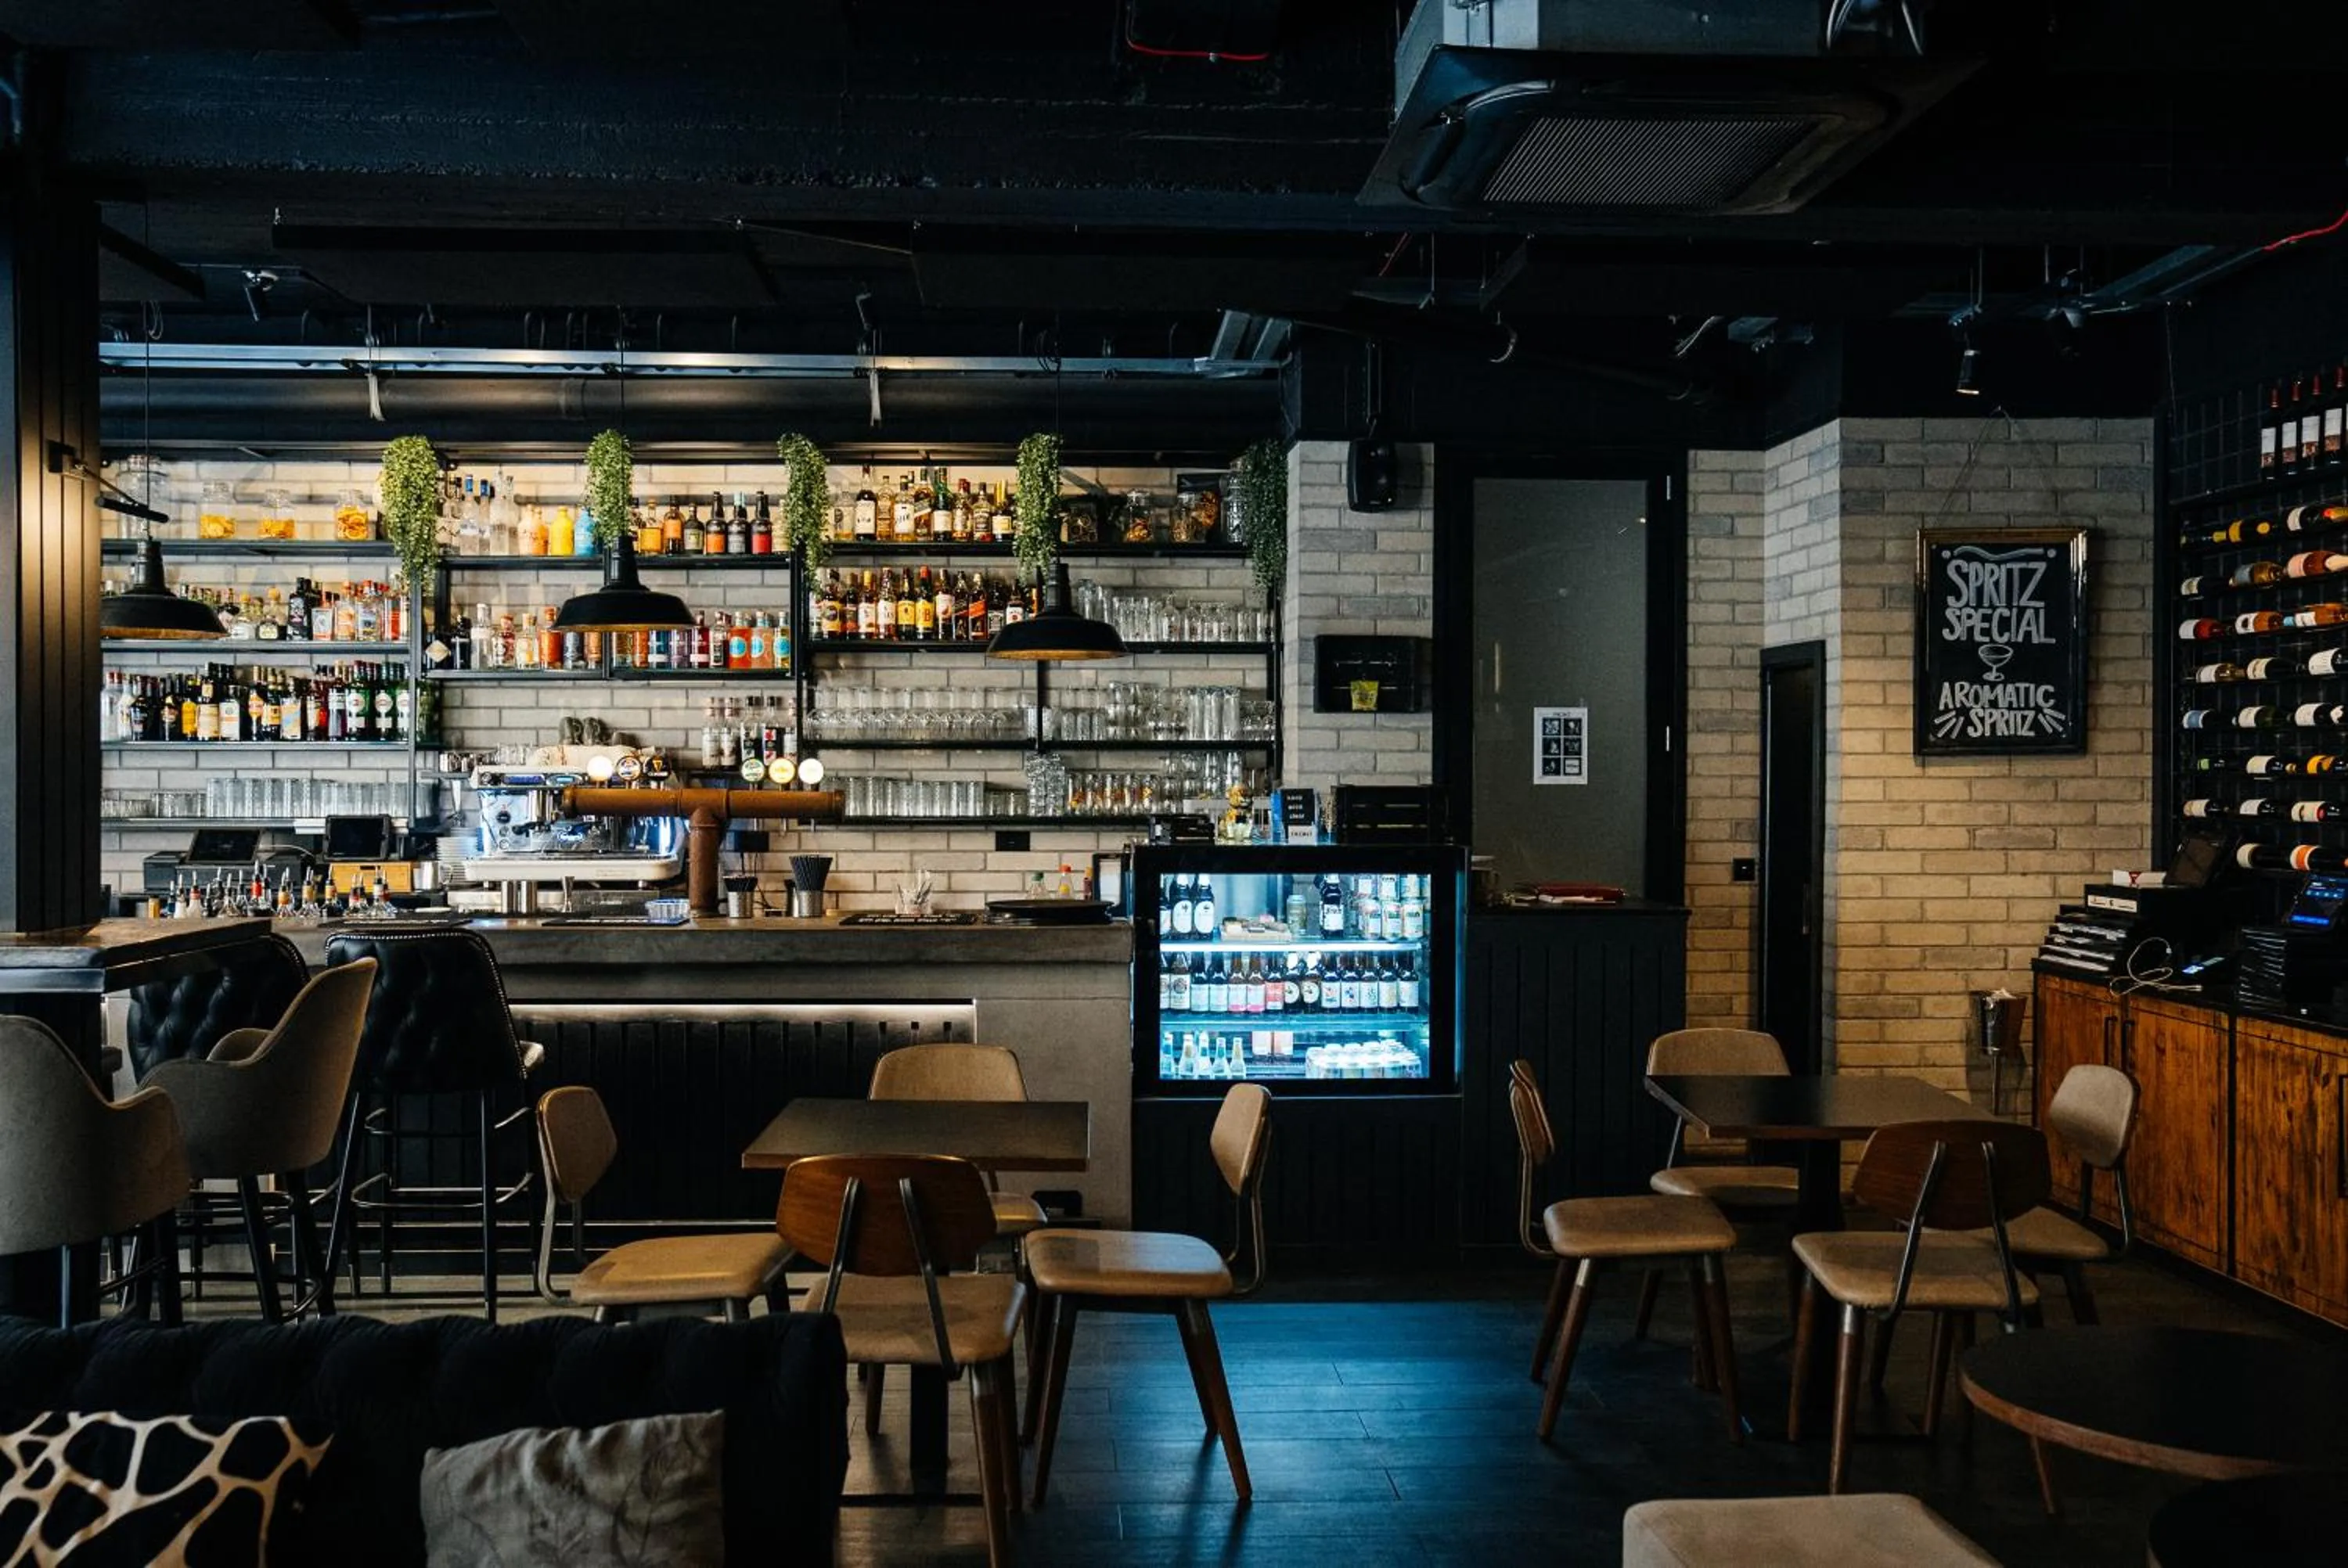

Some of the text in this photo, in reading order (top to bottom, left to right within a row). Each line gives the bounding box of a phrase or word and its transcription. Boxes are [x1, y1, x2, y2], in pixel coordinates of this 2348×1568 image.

[1946, 559, 2047, 608] SPRITZ
[1942, 608, 2056, 643] SPECIAL
[1939, 682, 2055, 710] AROMATIC
[1967, 709, 2036, 738] SPRITZ
